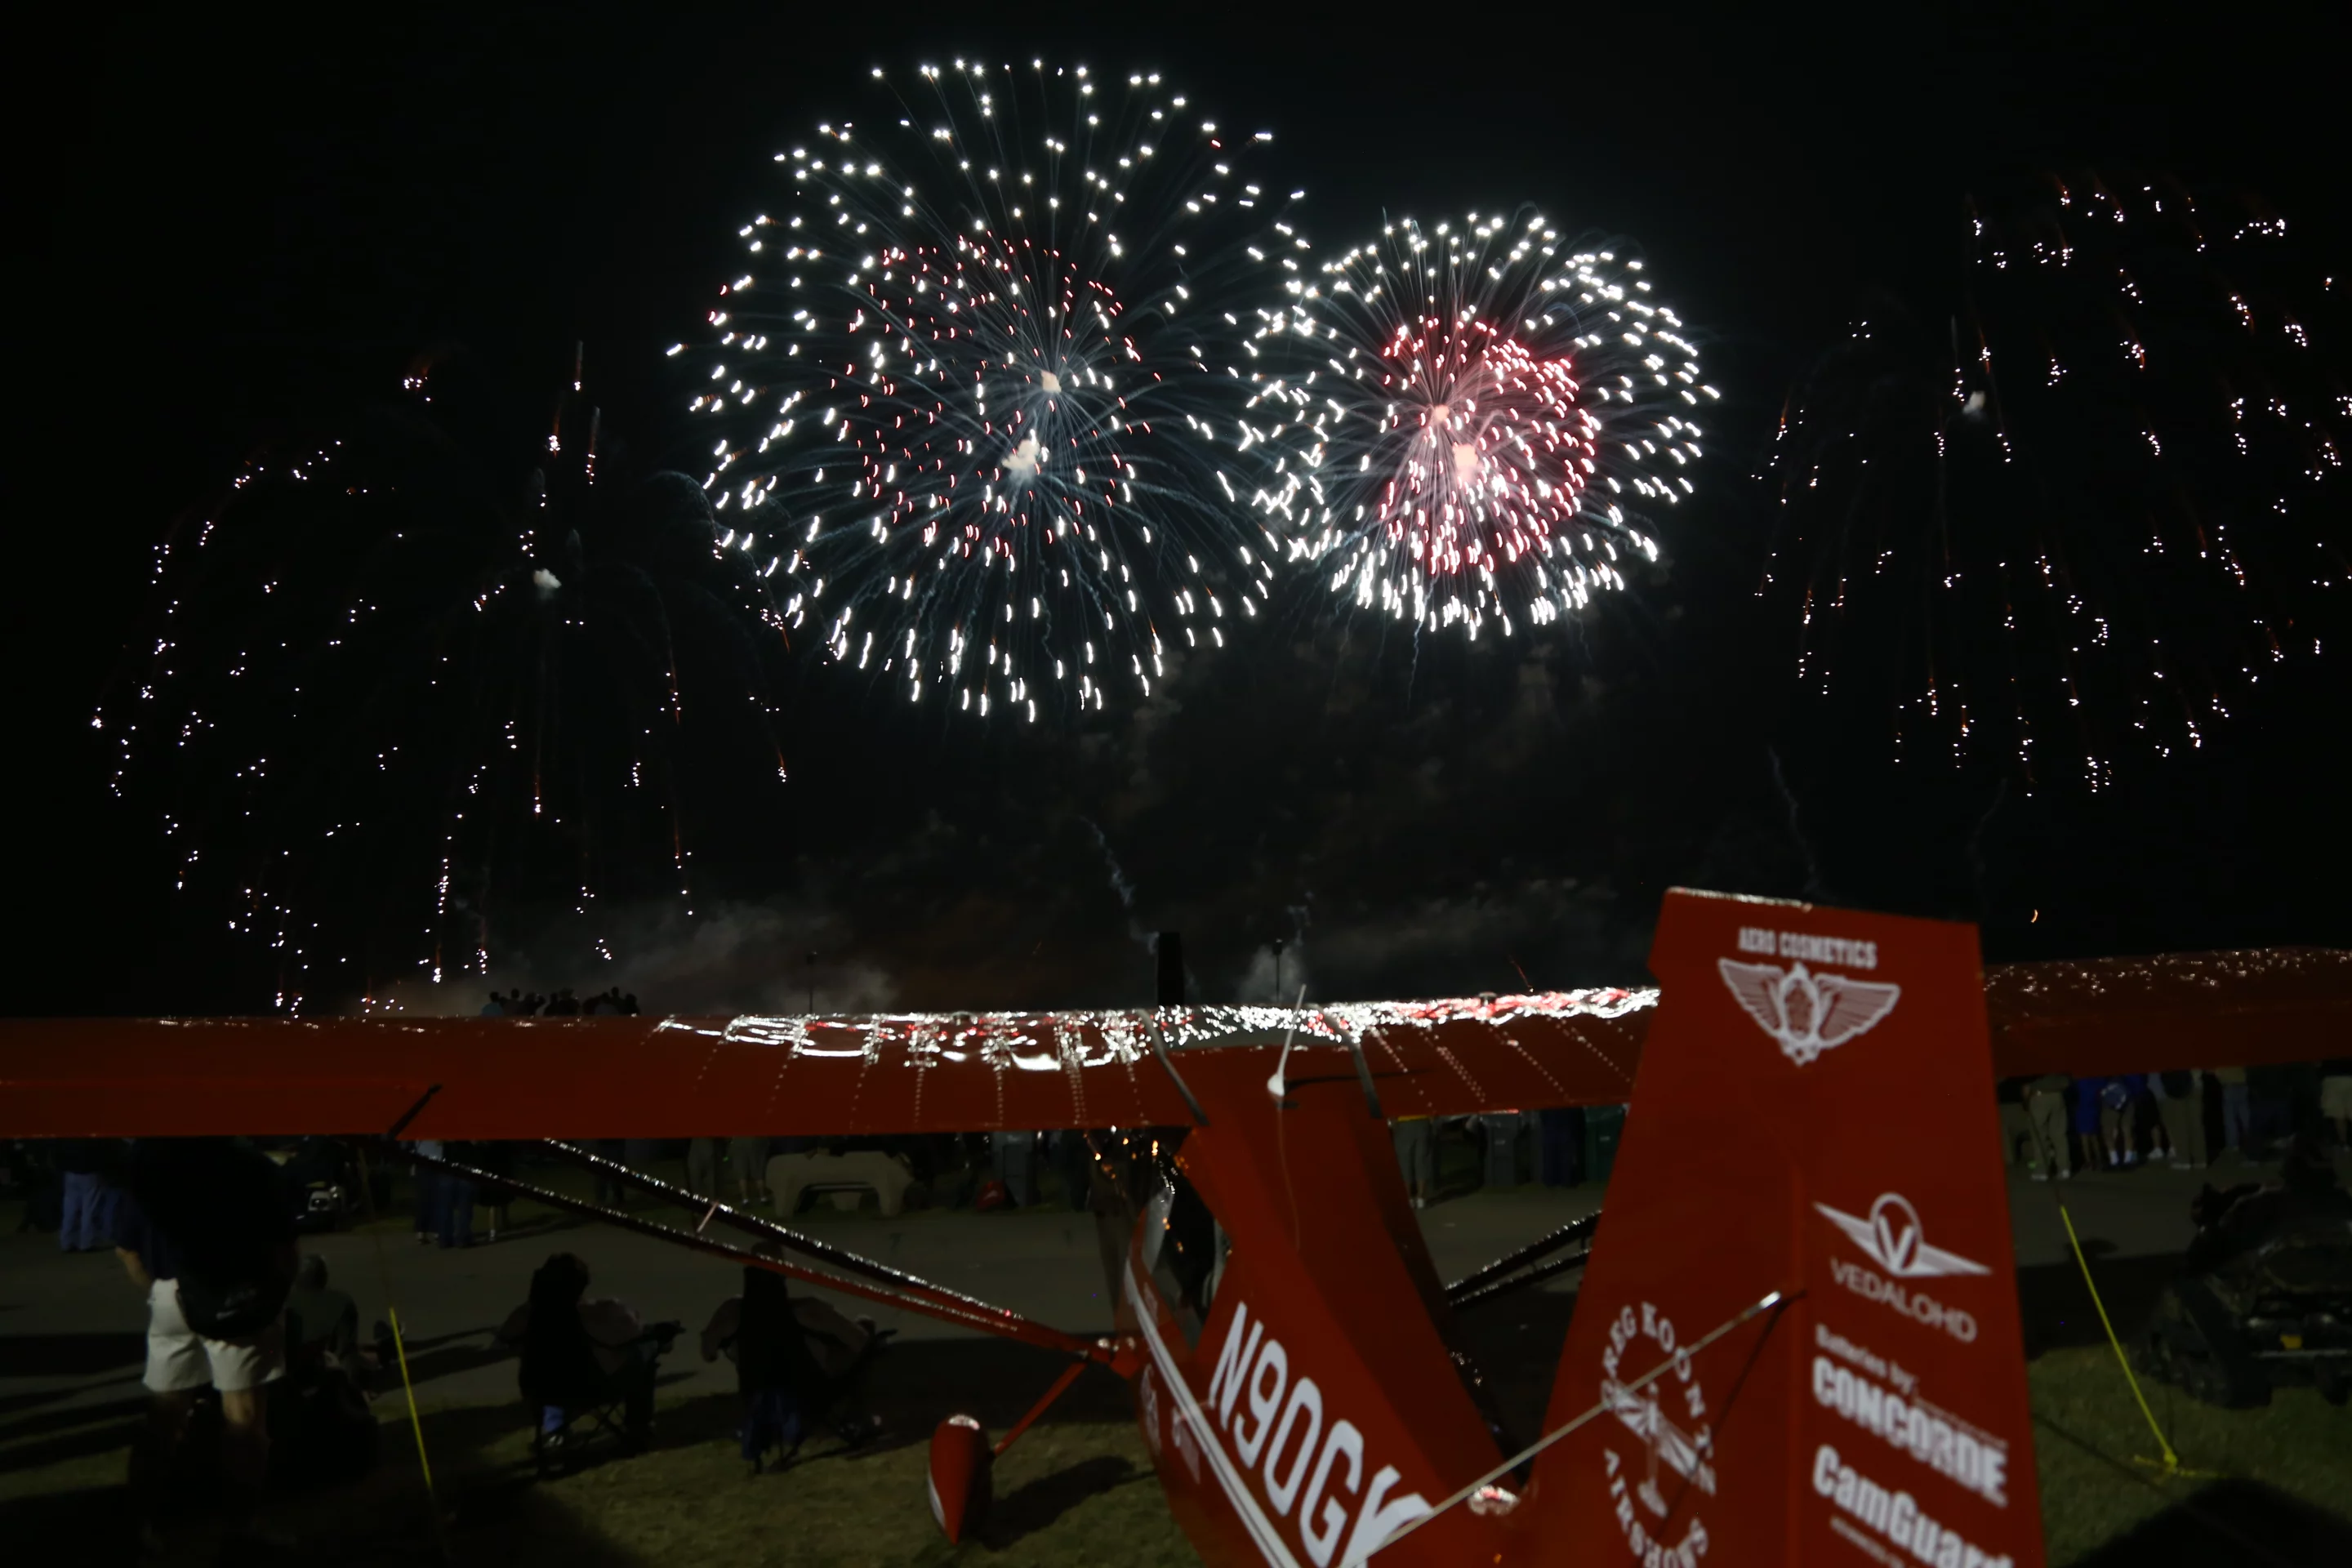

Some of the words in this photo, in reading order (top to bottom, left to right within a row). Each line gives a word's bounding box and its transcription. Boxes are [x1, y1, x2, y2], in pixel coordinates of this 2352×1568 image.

[1737, 924, 1776, 956] AERO
[1778, 929, 1878, 972] COSMETICS
[1811, 1354, 2009, 1497] CONCORDE
